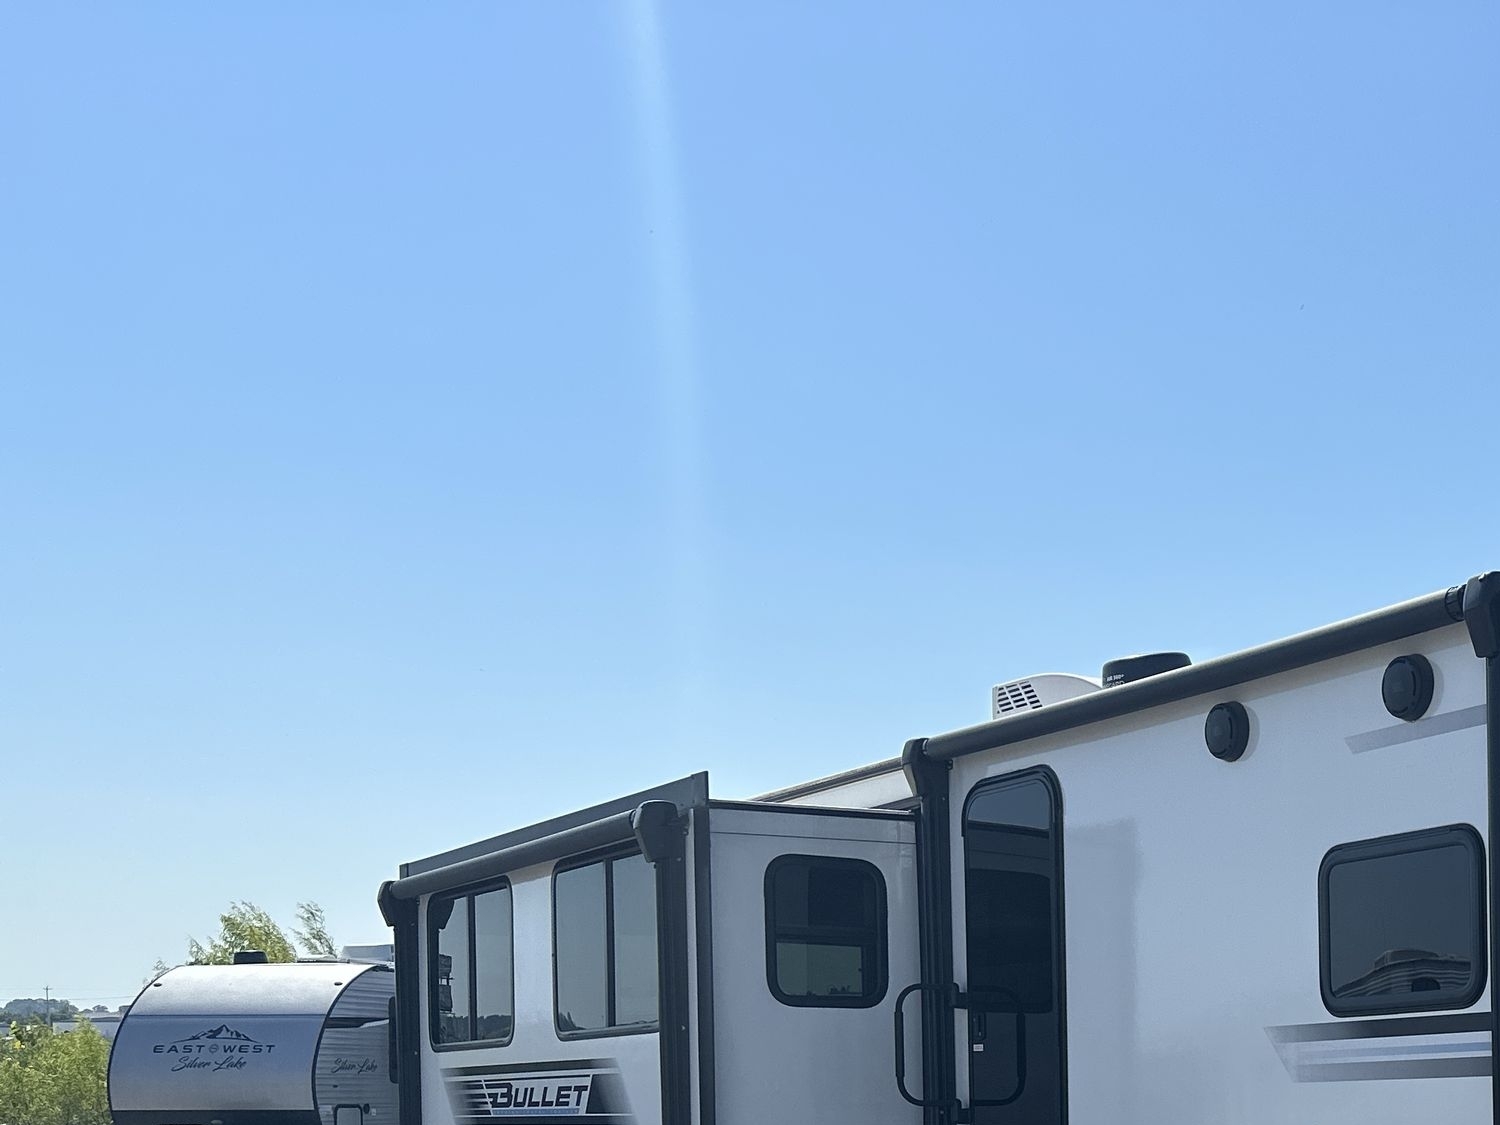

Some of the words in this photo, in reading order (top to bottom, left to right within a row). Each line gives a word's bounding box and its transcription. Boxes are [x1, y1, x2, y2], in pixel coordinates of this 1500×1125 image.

[152, 1044, 206, 1054] EAST
[223, 1044, 276, 1054] WEST
[171, 1056, 211, 1072] Silver
[212, 1055, 247, 1072] Lake
[331, 1057, 357, 1073] Silver
[357, 1057, 378, 1074] Lake
[485, 1082, 589, 1108] BULLET
